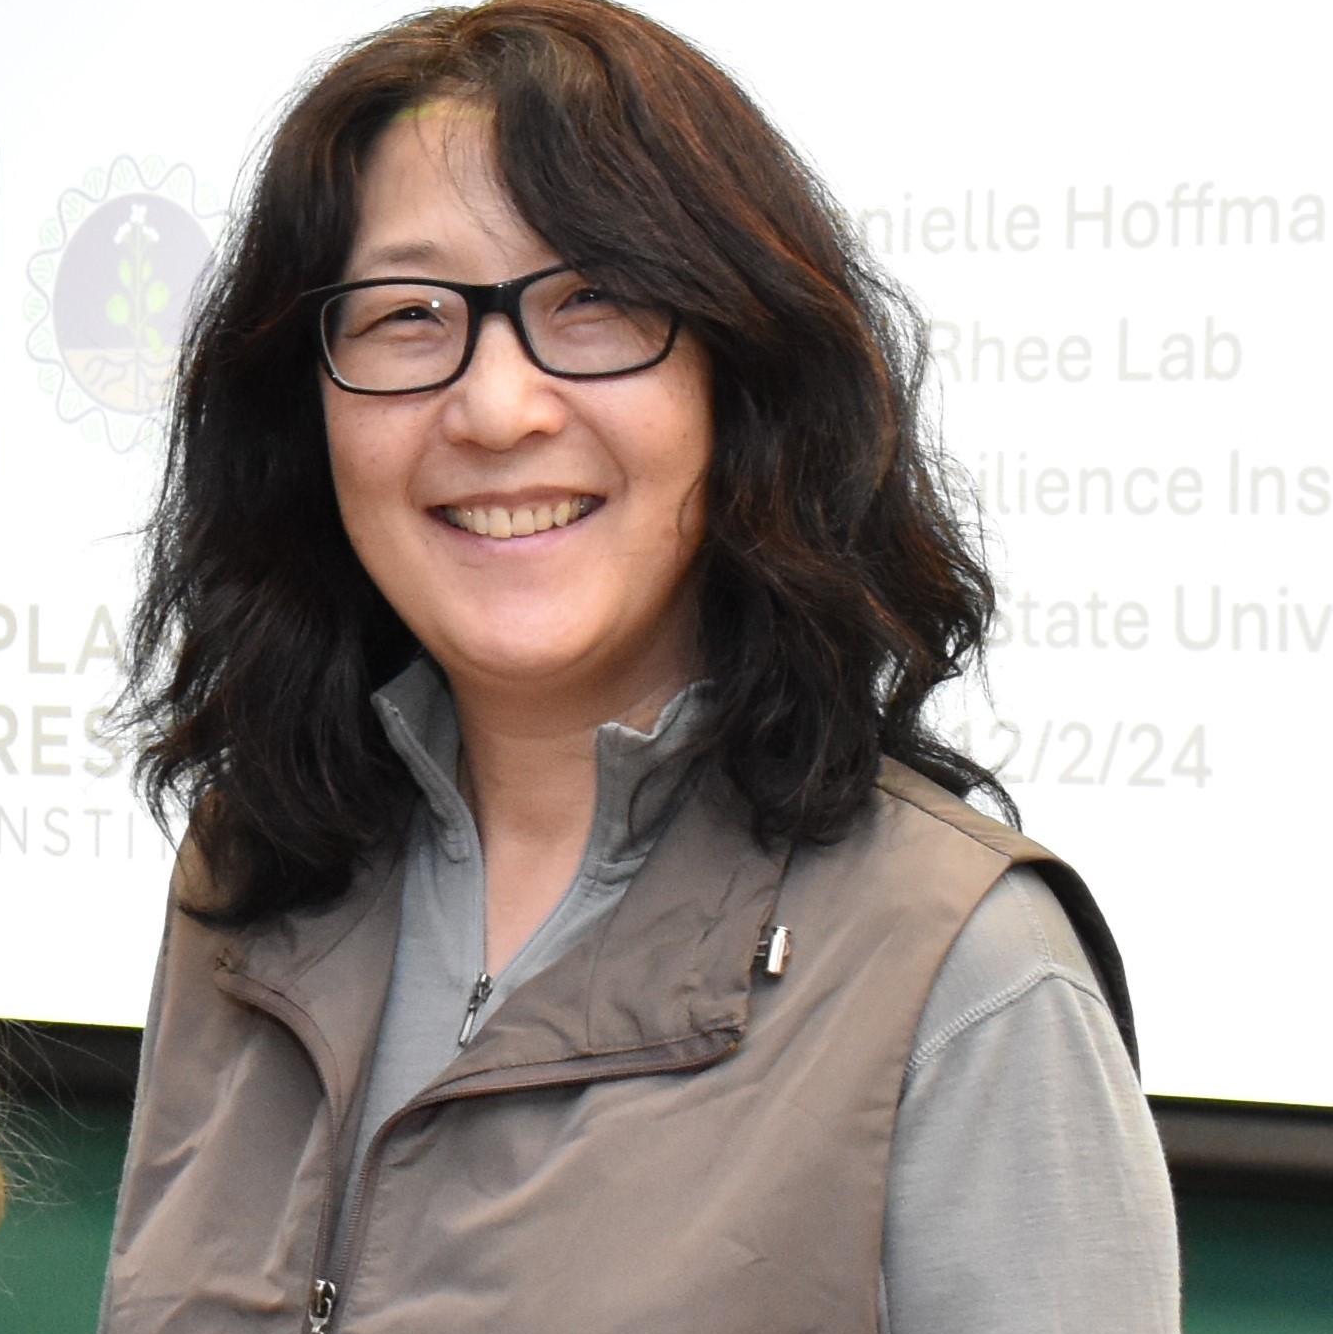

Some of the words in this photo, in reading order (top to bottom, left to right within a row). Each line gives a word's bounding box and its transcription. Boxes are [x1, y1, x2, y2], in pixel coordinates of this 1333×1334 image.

[851, 189, 1041, 255] nielle
[1065, 180, 1325, 251] Hoffma
[928, 317, 1092, 384] Rhee
[1118, 315, 1243, 383] Lab
[1228, 448, 1333, 516] Ins
[1174, 584, 1333, 652] Univ
